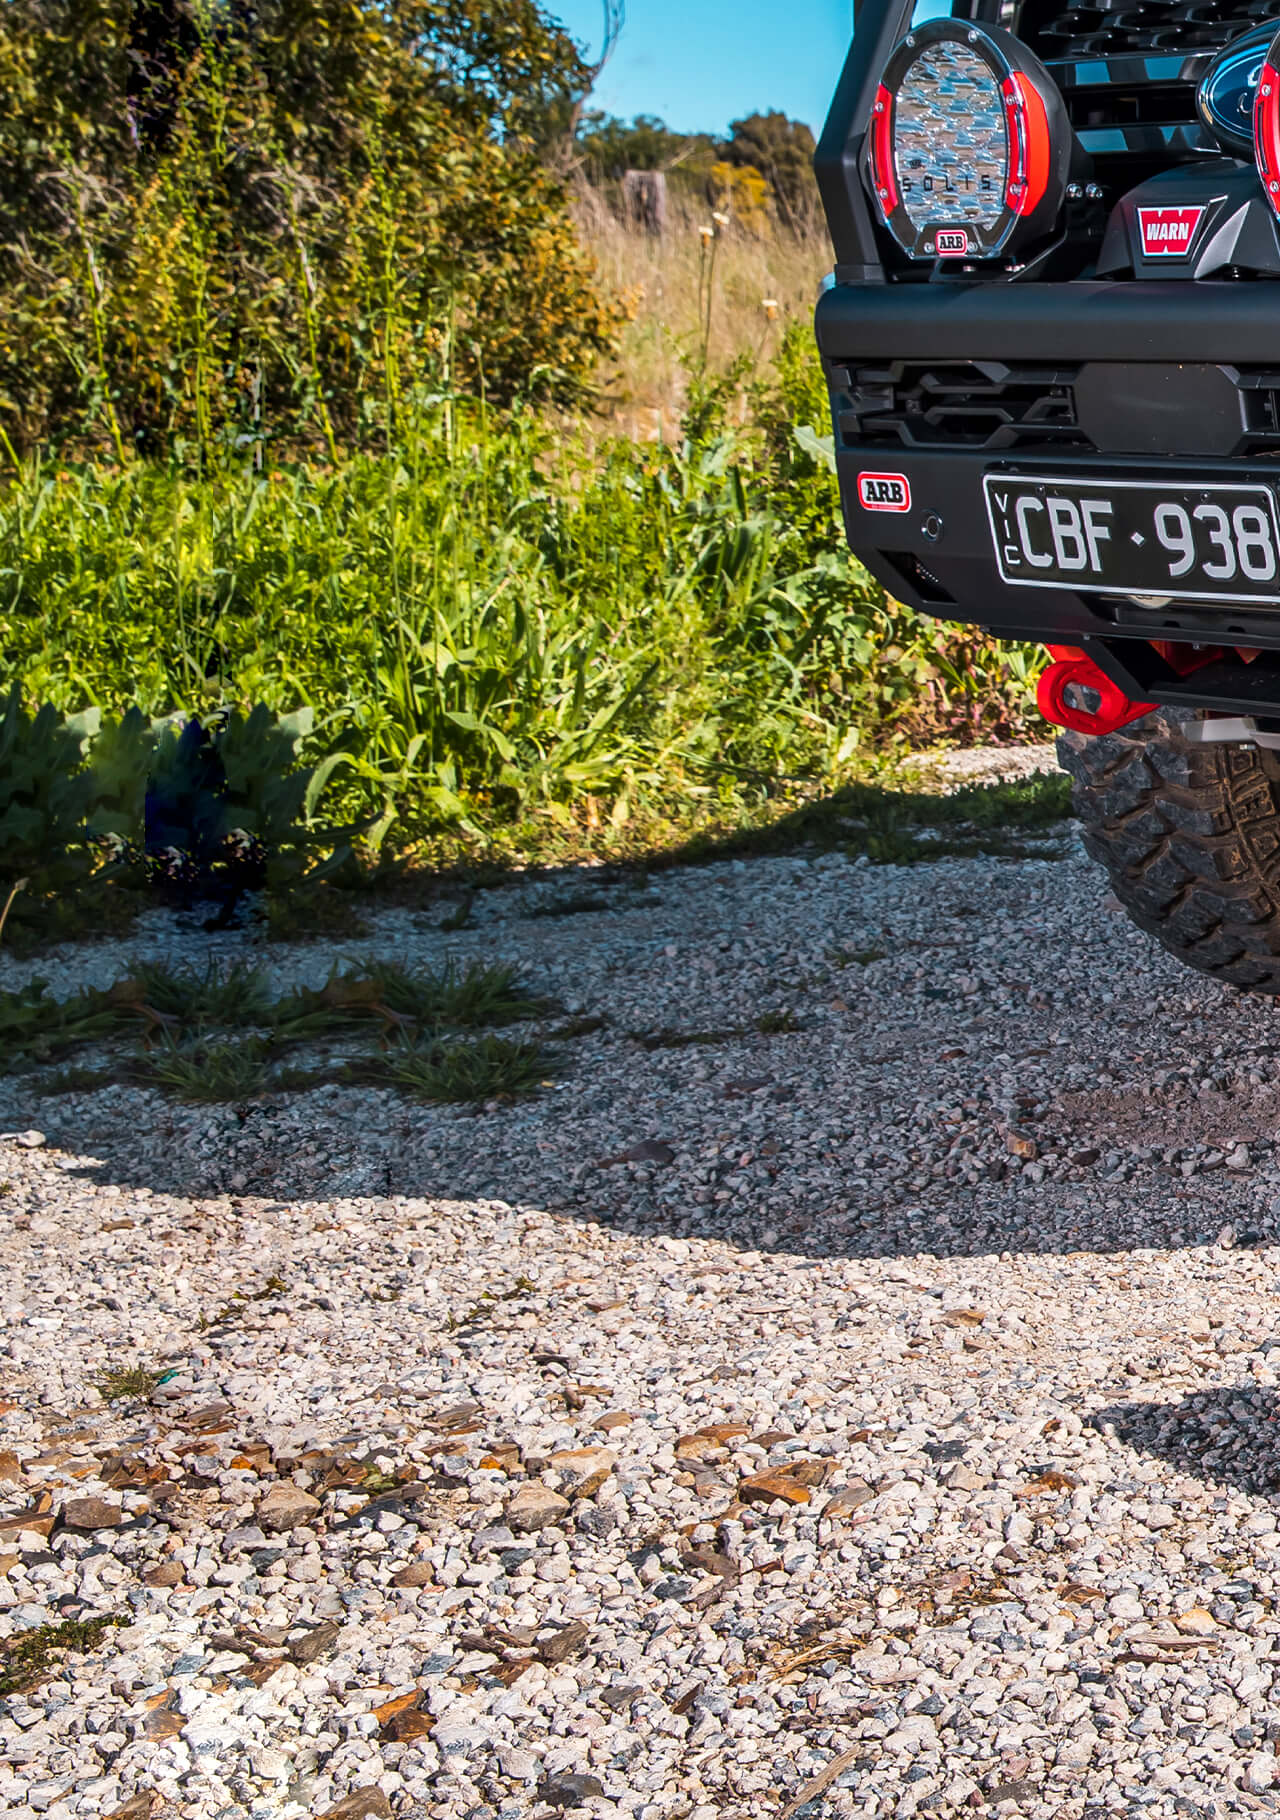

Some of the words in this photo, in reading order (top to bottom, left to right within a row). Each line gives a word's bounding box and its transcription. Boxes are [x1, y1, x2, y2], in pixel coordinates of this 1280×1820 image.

[902, 175, 991, 192] SOLIS
[1146, 222, 1190, 241] WARN
[939, 236, 964, 249] ARB
[865, 480, 904, 503] ARB
[995, 493, 1021, 564] VIC
[1015, 496, 1113, 571] CBF
[1153, 503, 1276, 581] 938
